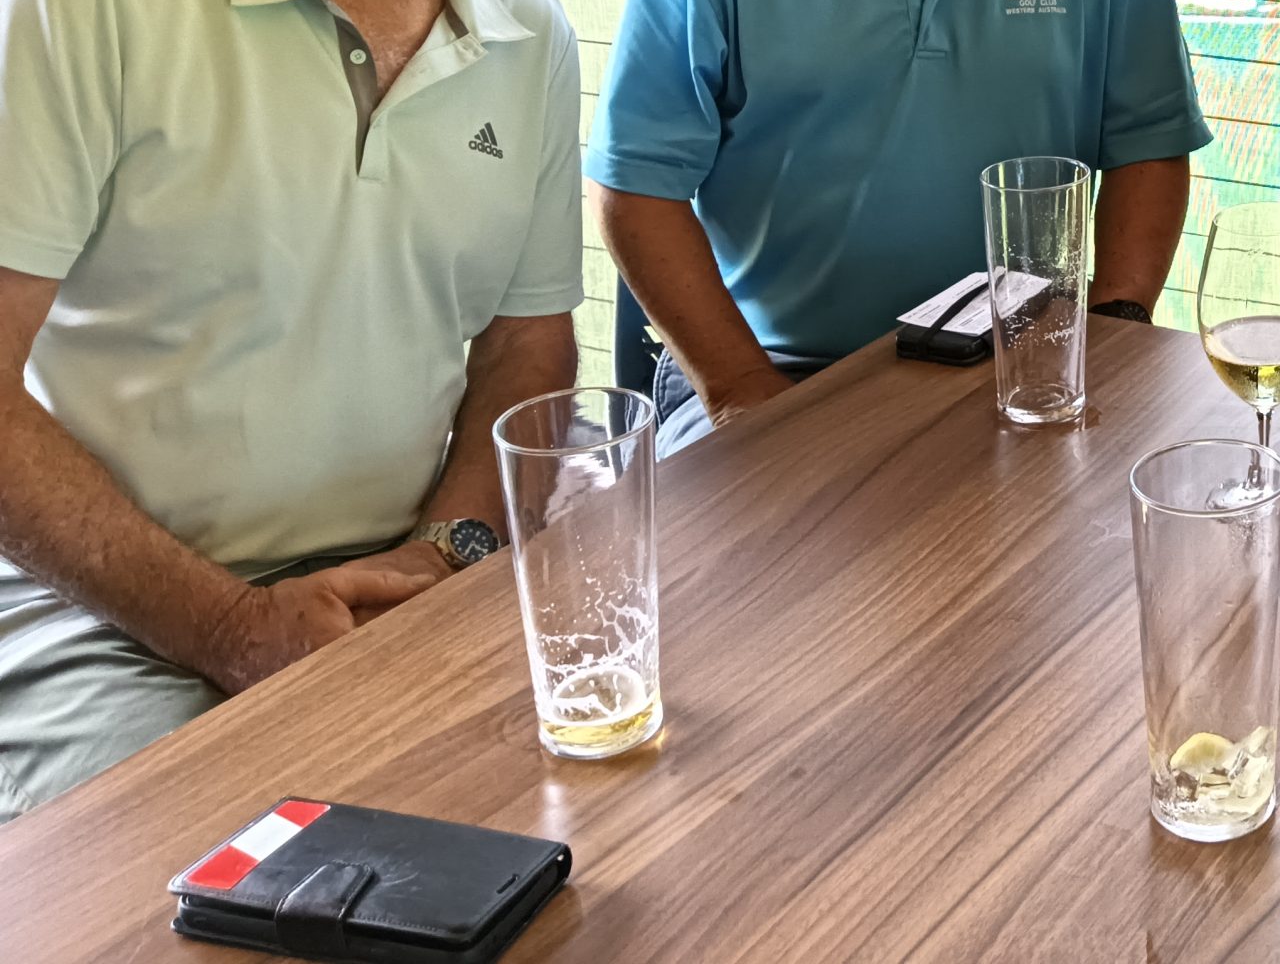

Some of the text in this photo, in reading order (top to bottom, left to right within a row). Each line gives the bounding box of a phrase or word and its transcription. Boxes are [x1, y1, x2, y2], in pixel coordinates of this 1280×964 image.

[1019, 0, 1036, 7] GOLF
[1006, 7, 1035, 15] WESTERN
[468, 140, 504, 160] adidas
